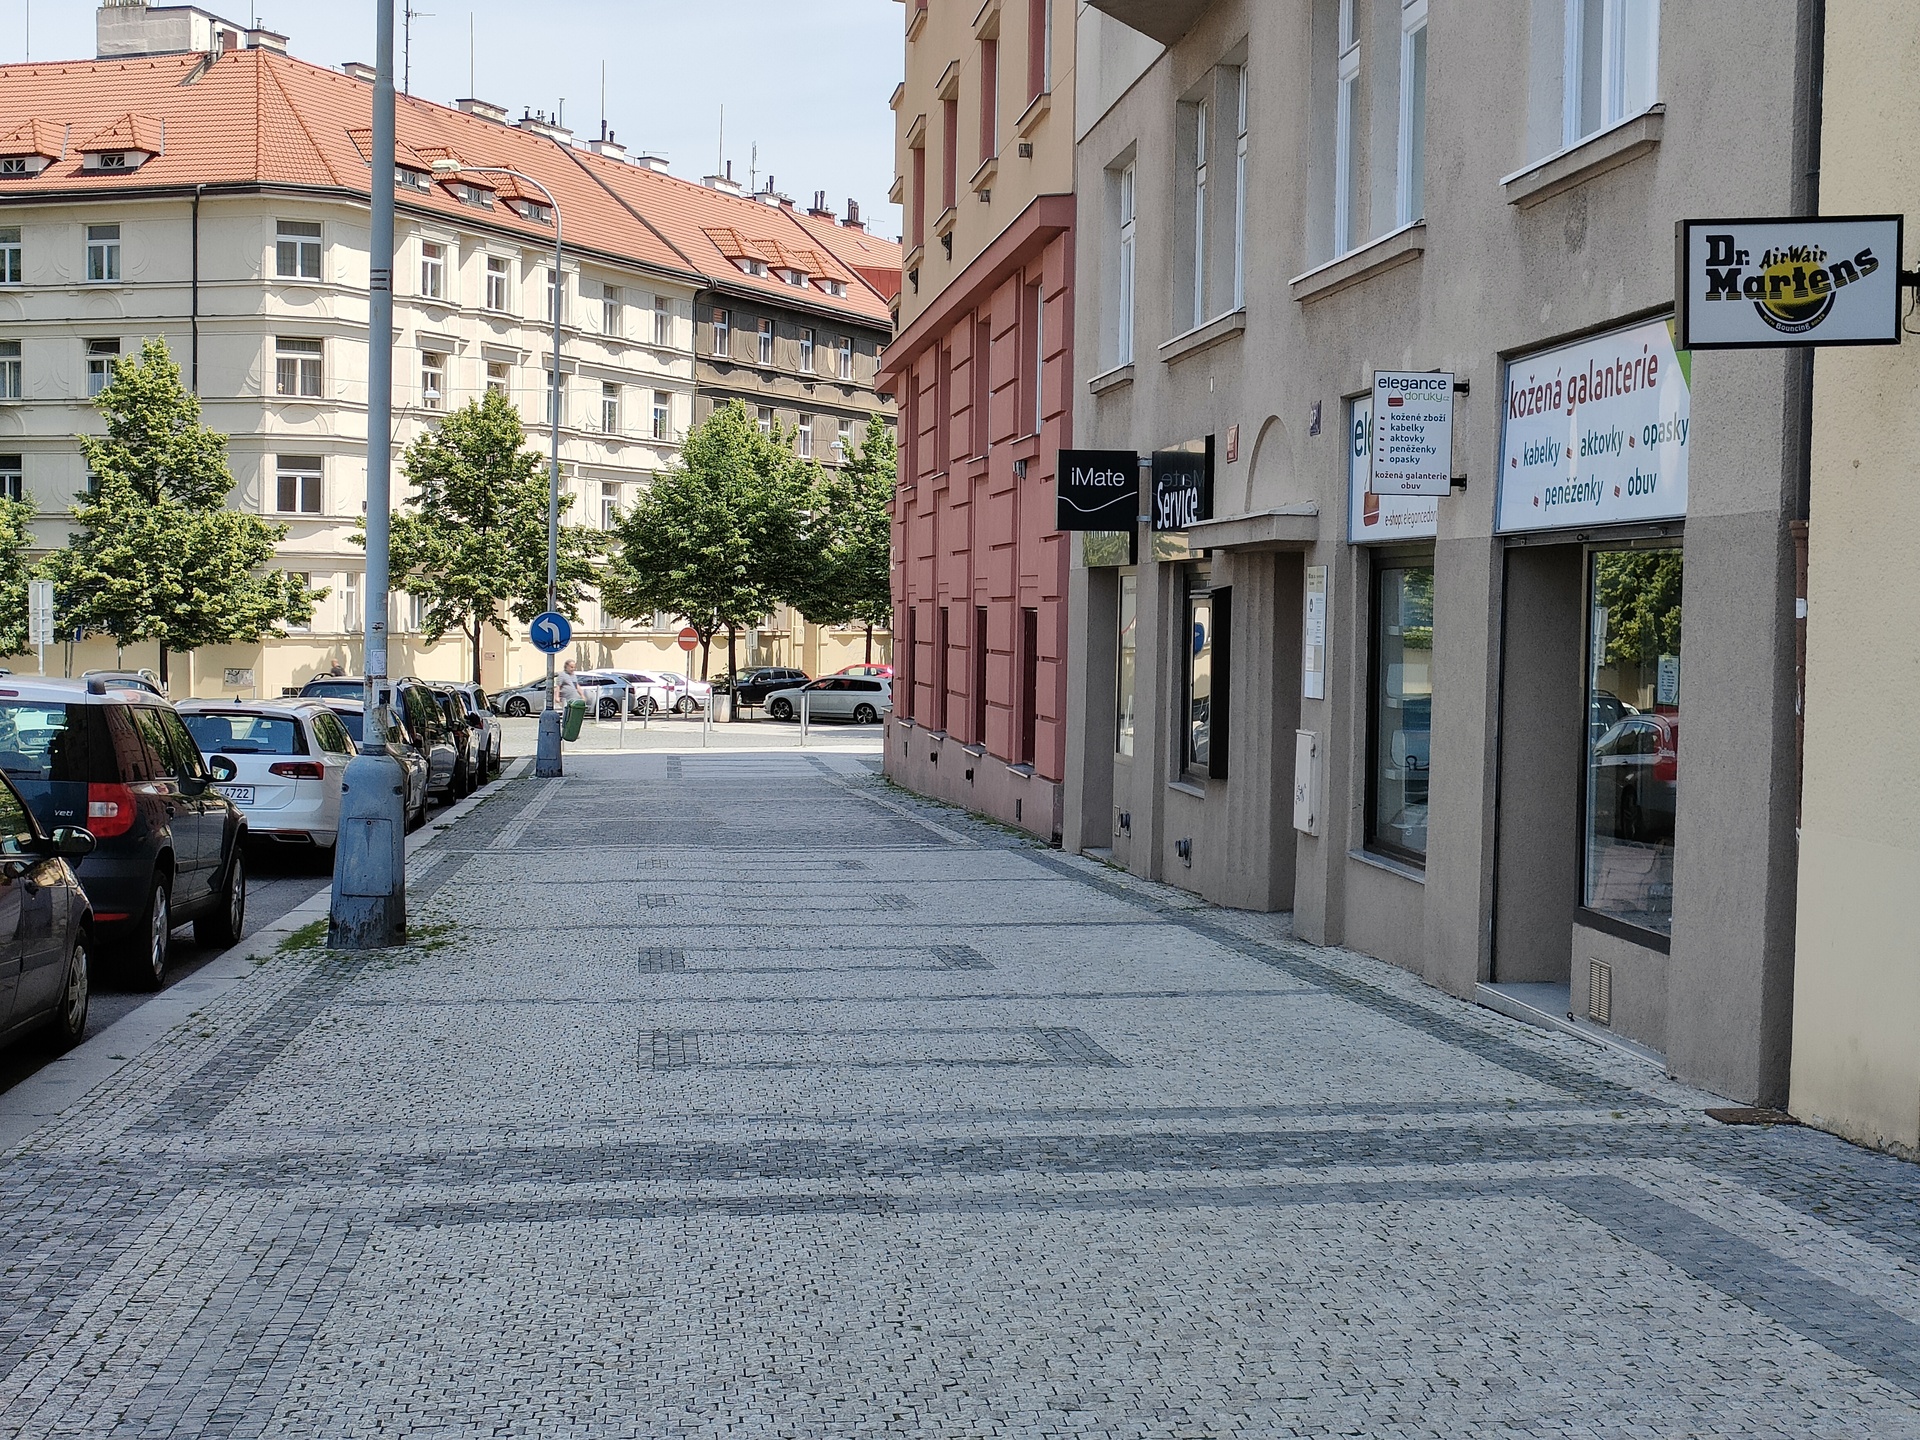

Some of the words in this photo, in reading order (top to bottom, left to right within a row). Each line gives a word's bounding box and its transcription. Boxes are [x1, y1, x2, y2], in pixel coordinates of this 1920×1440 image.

[1706, 235, 1750, 267] Dr.
[1759, 245, 1828, 269] AirWair
[1705, 247, 1880, 301] Martens
[1775, 323, 1811, 332] Bouncing
[1378, 376, 1447, 391] elegance
[1509, 367, 1562, 420] kožená
[1566, 344, 1659, 416] galanterie
[1390, 412, 1422, 421] kožené
[1423, 413, 1447, 422] zboží
[1390, 423, 1425, 433] kabelky
[1390, 433, 1425, 444] aktovky
[1523, 437, 1561, 467] kabelky
[1580, 424, 1624, 457] aktovky
[1643, 411, 1690, 451] opasky
[1389, 444, 1437, 455] peněženky
[1389, 455, 1421, 465] opasky
[1071, 466, 1125, 487] iMate
[1375, 470, 1404, 479] kožená
[1405, 471, 1448, 481] galanterie
[1400, 481, 1421, 490] obuv
[1544, 474, 1604, 512] peněženky
[1627, 467, 1658, 497] obuv
[1156, 474, 1198, 530] Service
[224, 787, 249, 799] 4722
